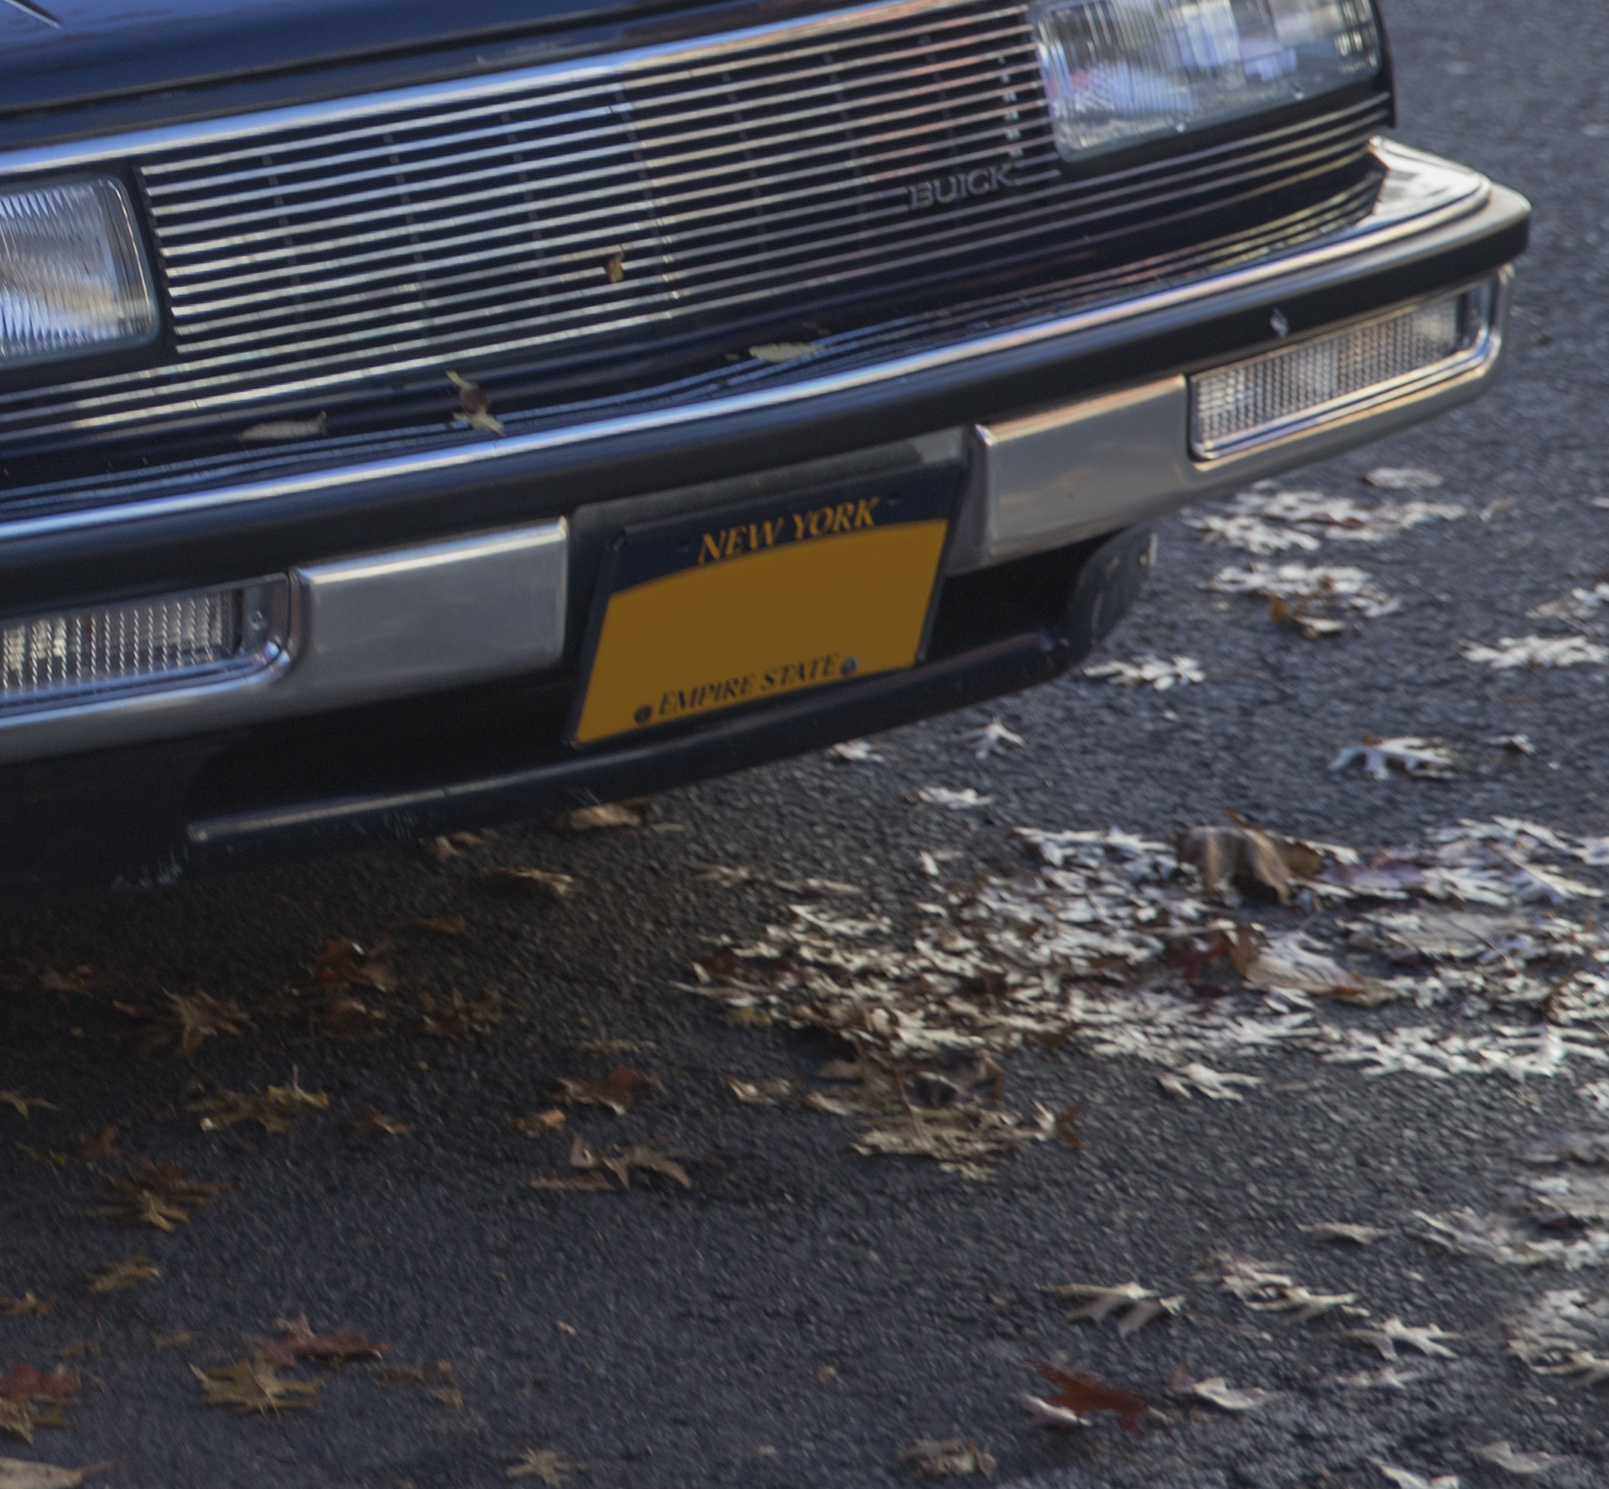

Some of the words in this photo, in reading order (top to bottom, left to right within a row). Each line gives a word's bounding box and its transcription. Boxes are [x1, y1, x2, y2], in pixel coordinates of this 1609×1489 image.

[907, 162, 1017, 210] BUICK
[698, 517, 785, 565] NEW
[792, 495, 880, 541] YORK
[658, 673, 757, 716] EMPIRE
[760, 651, 842, 691] STATE
